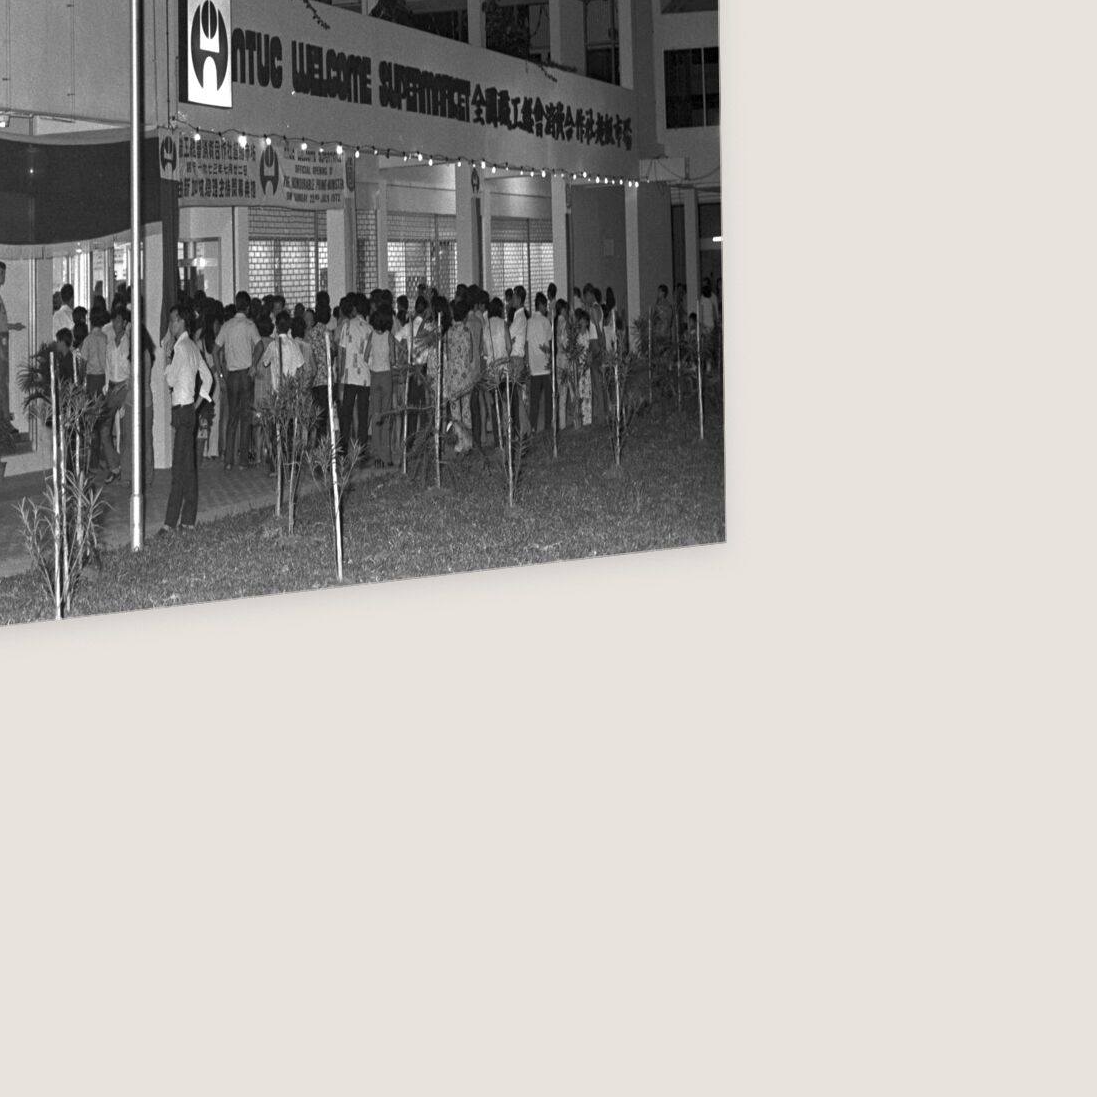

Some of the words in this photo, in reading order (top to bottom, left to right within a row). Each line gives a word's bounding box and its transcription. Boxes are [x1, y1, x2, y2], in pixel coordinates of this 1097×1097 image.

[232, 27, 283, 89] NTUC
[291, 40, 373, 105] WELCOME
[378, 60, 471, 123] SUPERMARKET
